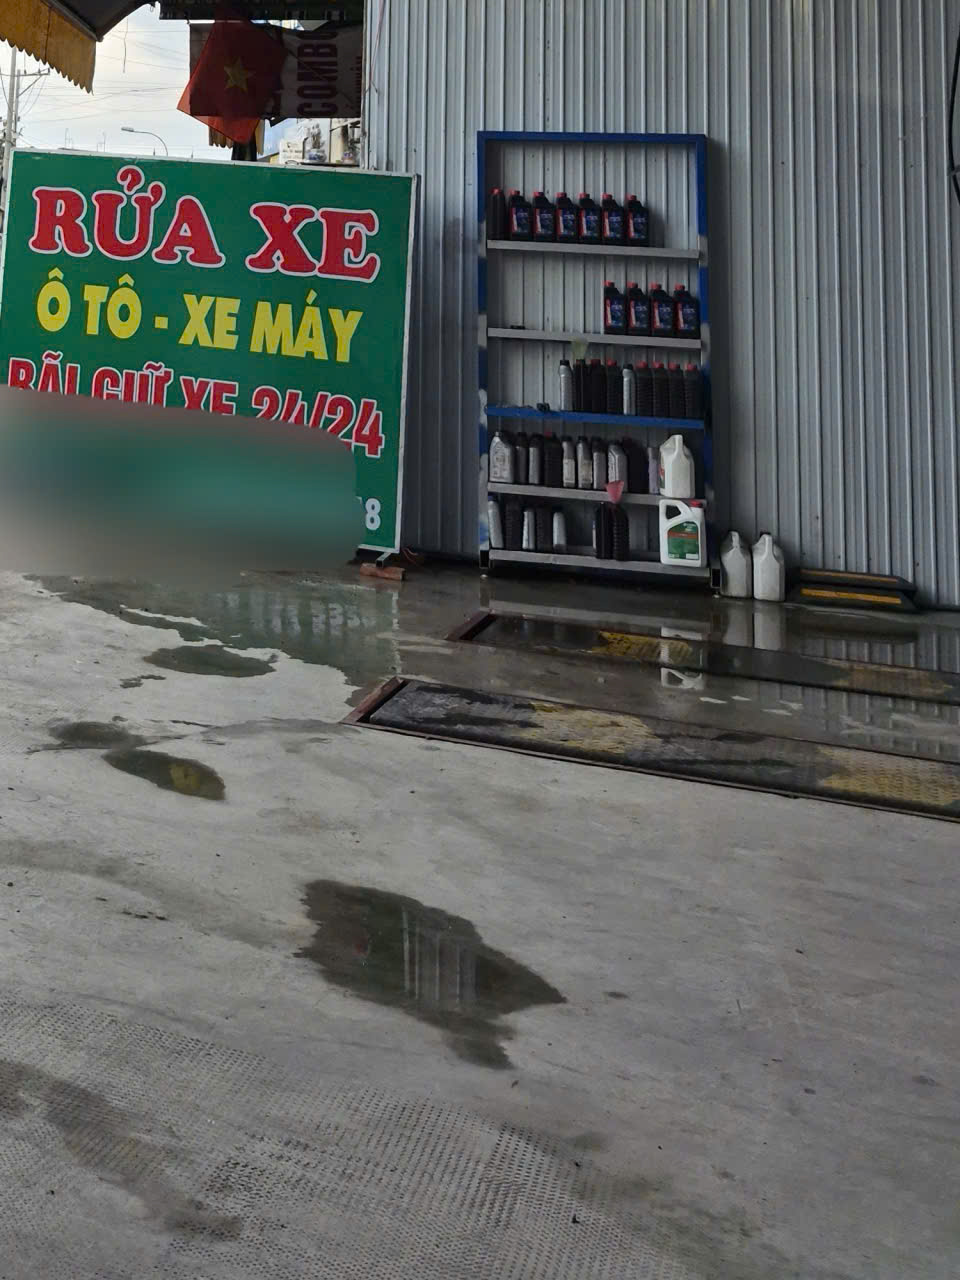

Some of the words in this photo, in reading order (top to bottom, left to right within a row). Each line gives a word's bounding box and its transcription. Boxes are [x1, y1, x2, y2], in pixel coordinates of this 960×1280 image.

[29, 164, 226, 268] RỬA
[245, 202, 381, 283] XE
[37, 266, 71, 332] Ô
[84, 273, 142, 339] TÔ
[178, 292, 240, 350] XE
[249, 288, 363, 363] MÁY
